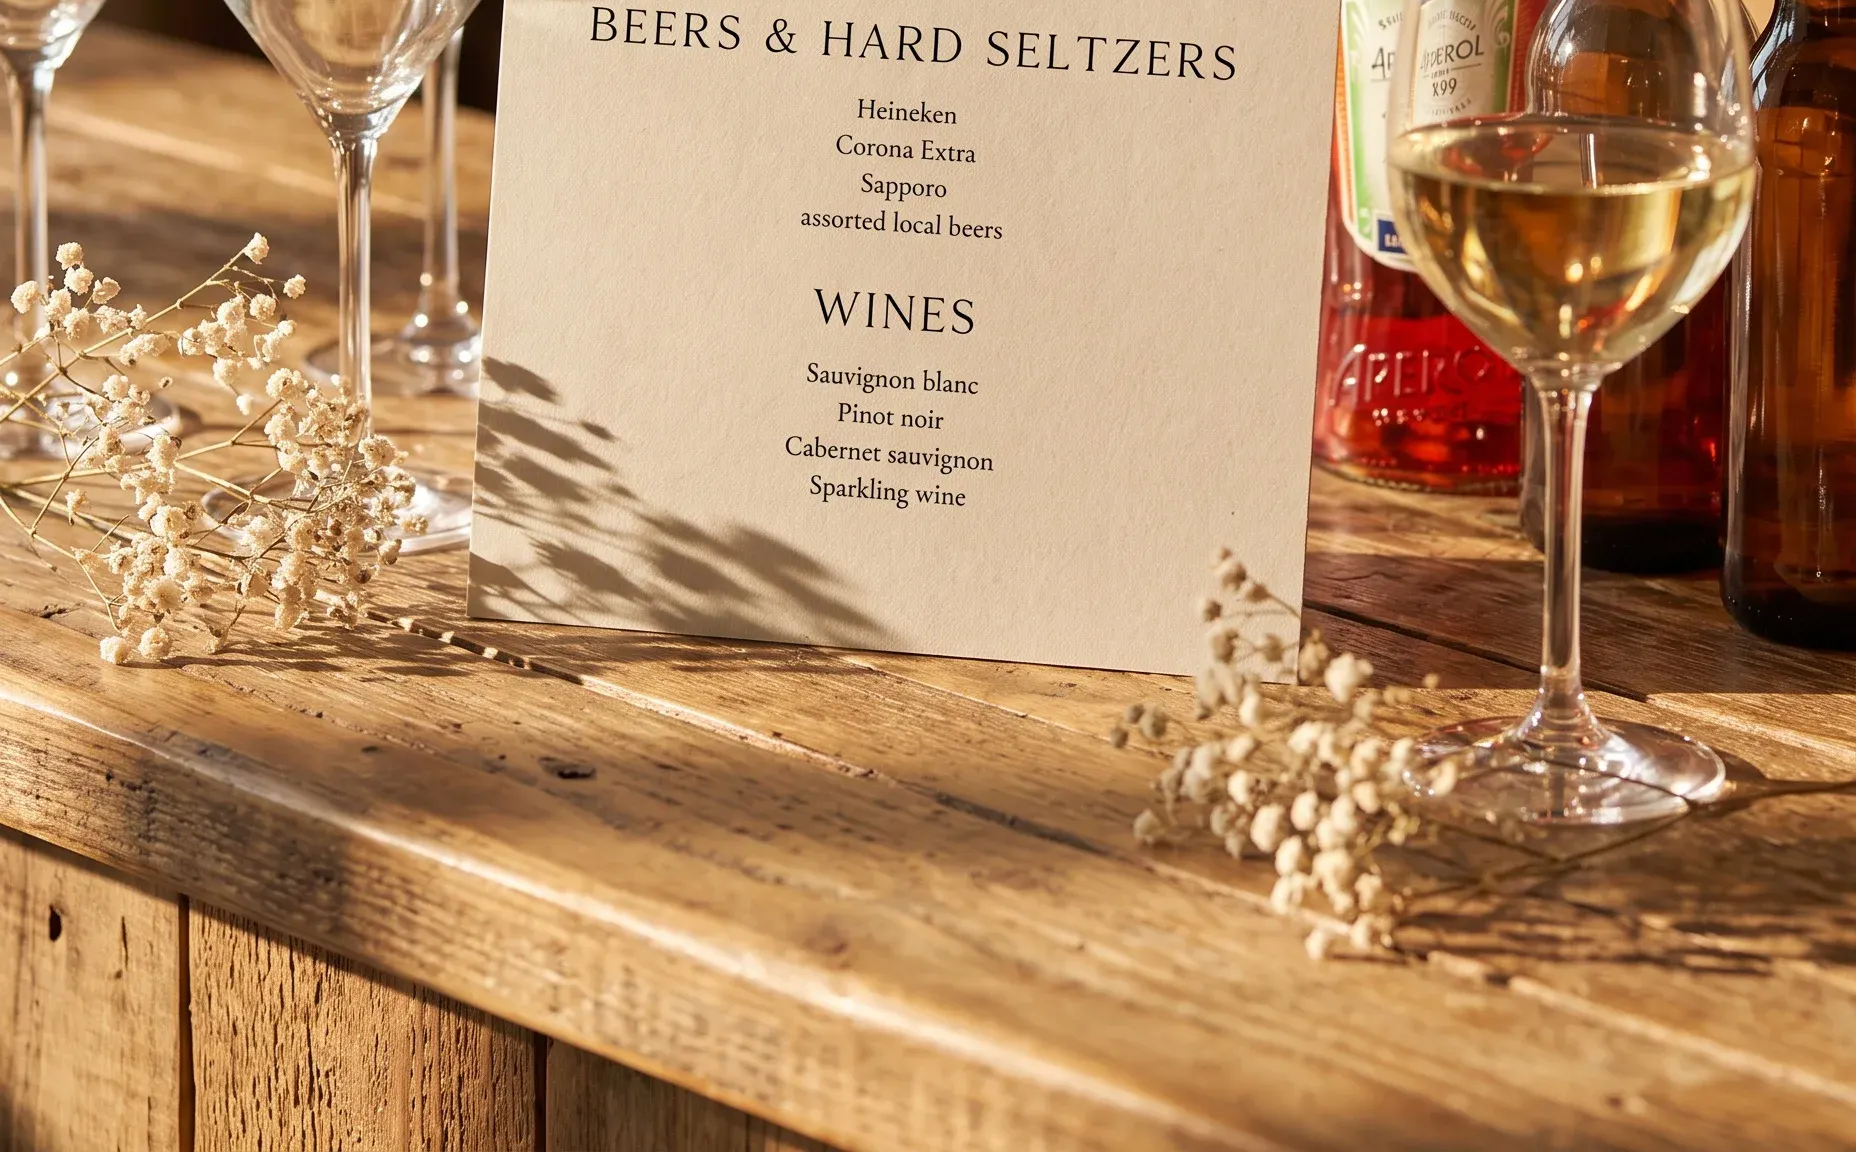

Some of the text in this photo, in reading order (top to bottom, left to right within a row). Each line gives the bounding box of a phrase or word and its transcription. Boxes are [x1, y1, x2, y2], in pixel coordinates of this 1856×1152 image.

[590, 6, 1237, 81] BEERS & HARD SELTZERS
[857, 98, 957, 125] Heineken
[835, 134, 977, 164] Corona Extra
[860, 172, 948, 203] Sapporo
[800, 209, 1003, 240] assorted local beers
[813, 288, 975, 336] WINES
[806, 362, 980, 395] Sauvignon blanc
[837, 402, 944, 430] Pinot noir
[785, 435, 994, 475] Cabernet sauvignon
[809, 474, 967, 509] Sparkling wine
